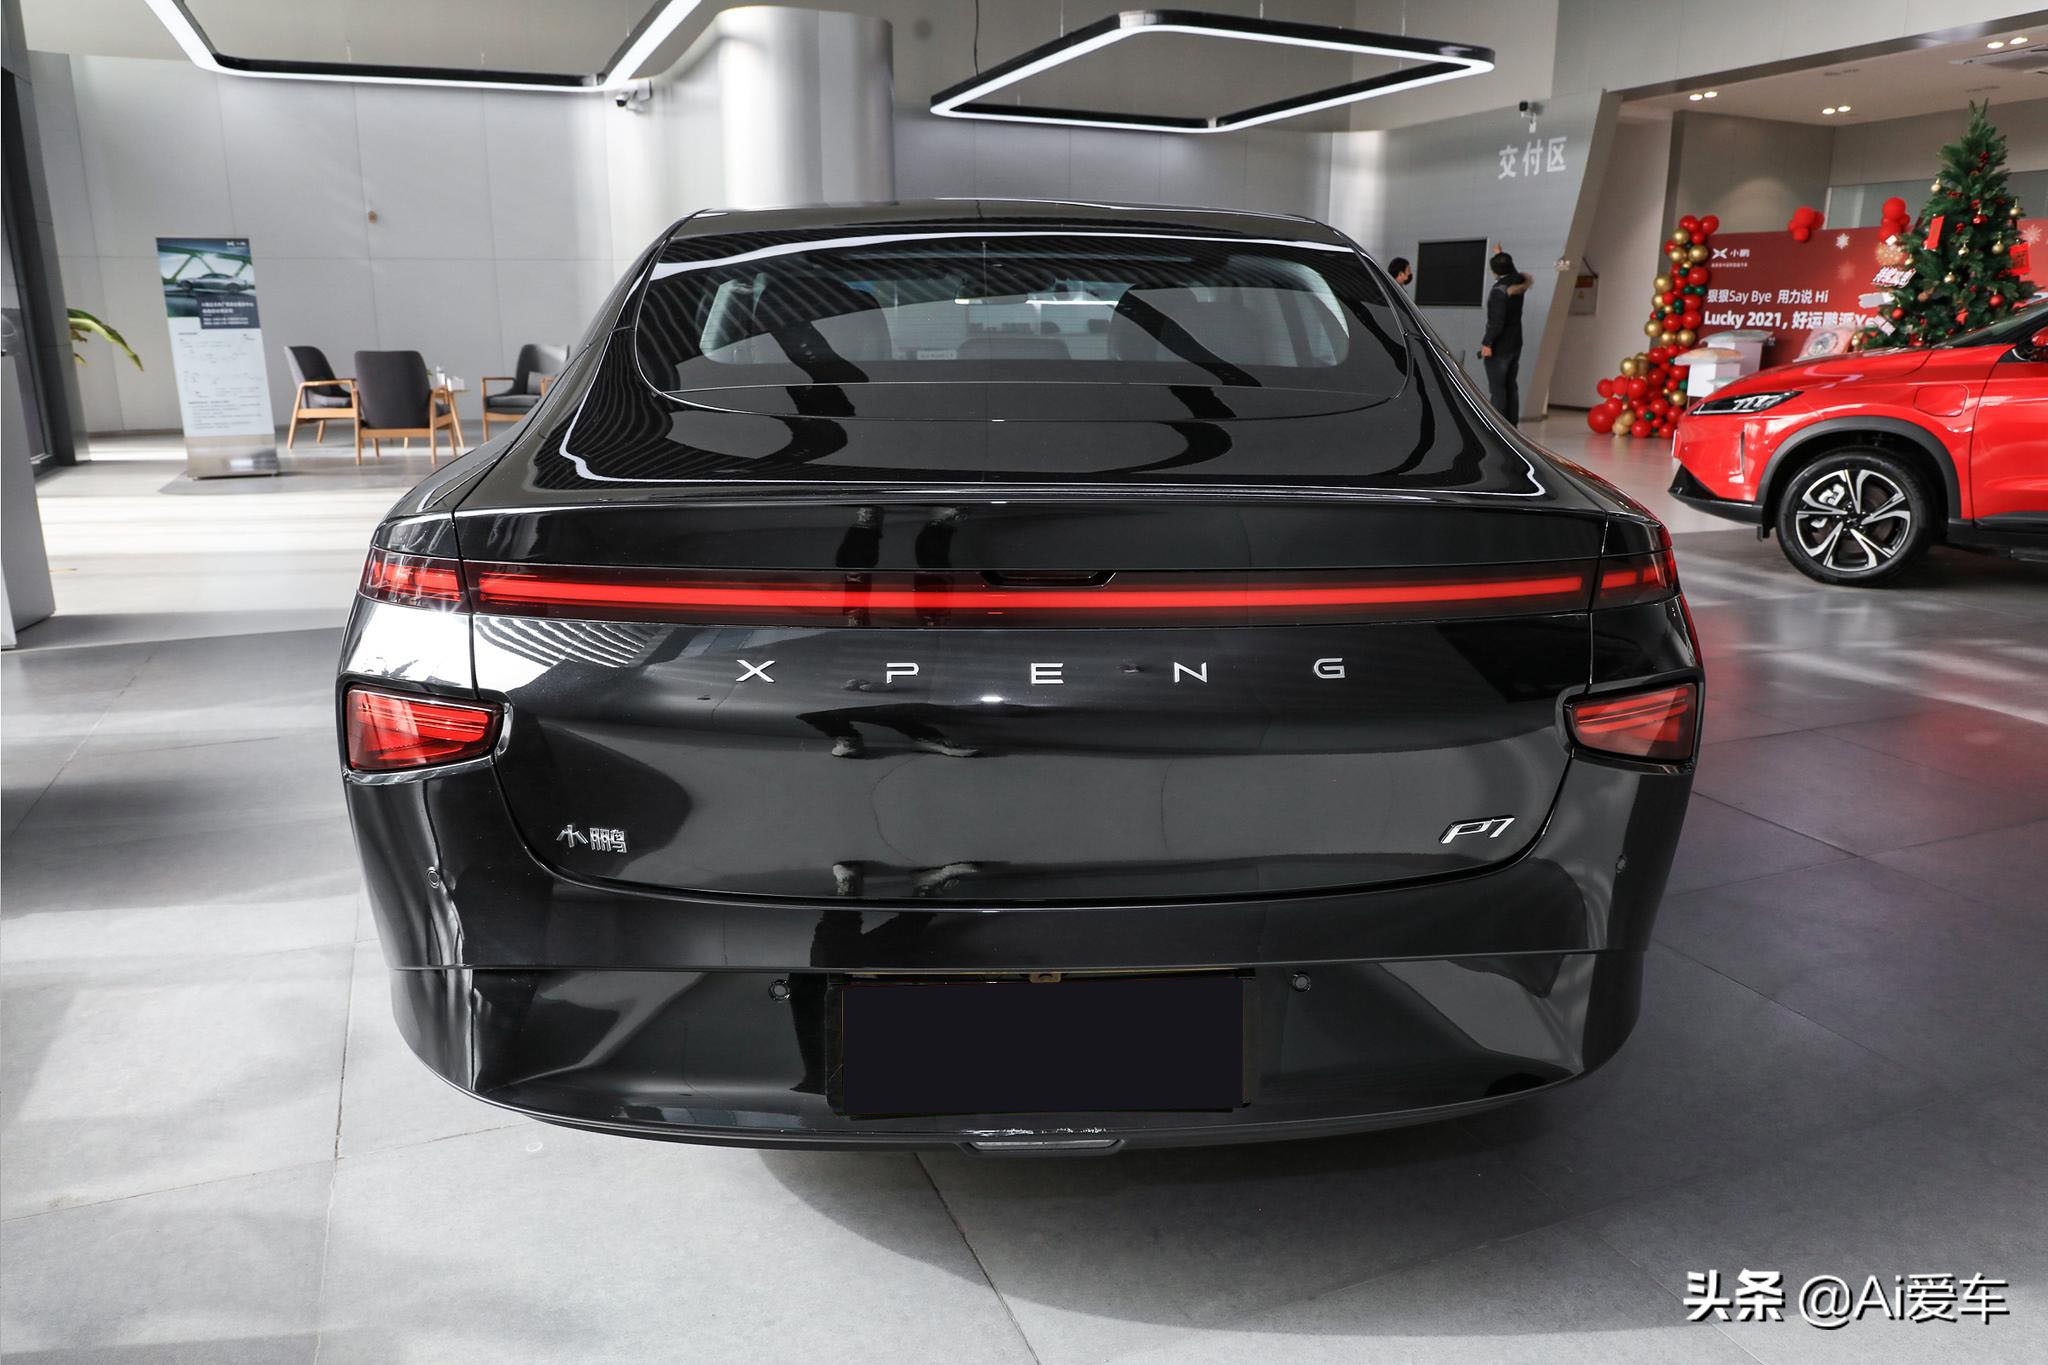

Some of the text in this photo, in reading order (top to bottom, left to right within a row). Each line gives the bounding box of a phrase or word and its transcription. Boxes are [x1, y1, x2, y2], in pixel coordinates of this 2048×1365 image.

[1498, 136, 1567, 180] 交付区
[1751, 290, 1772, 304] Bye
[1777, 289, 1812, 304] 用力说
[1815, 290, 1829, 303] Hi
[1704, 310, 1745, 329] Lucky
[735, 657, 1346, 684] XPENG
[556, 824, 627, 853] 小鹏
[1440, 817, 1515, 844] P7
